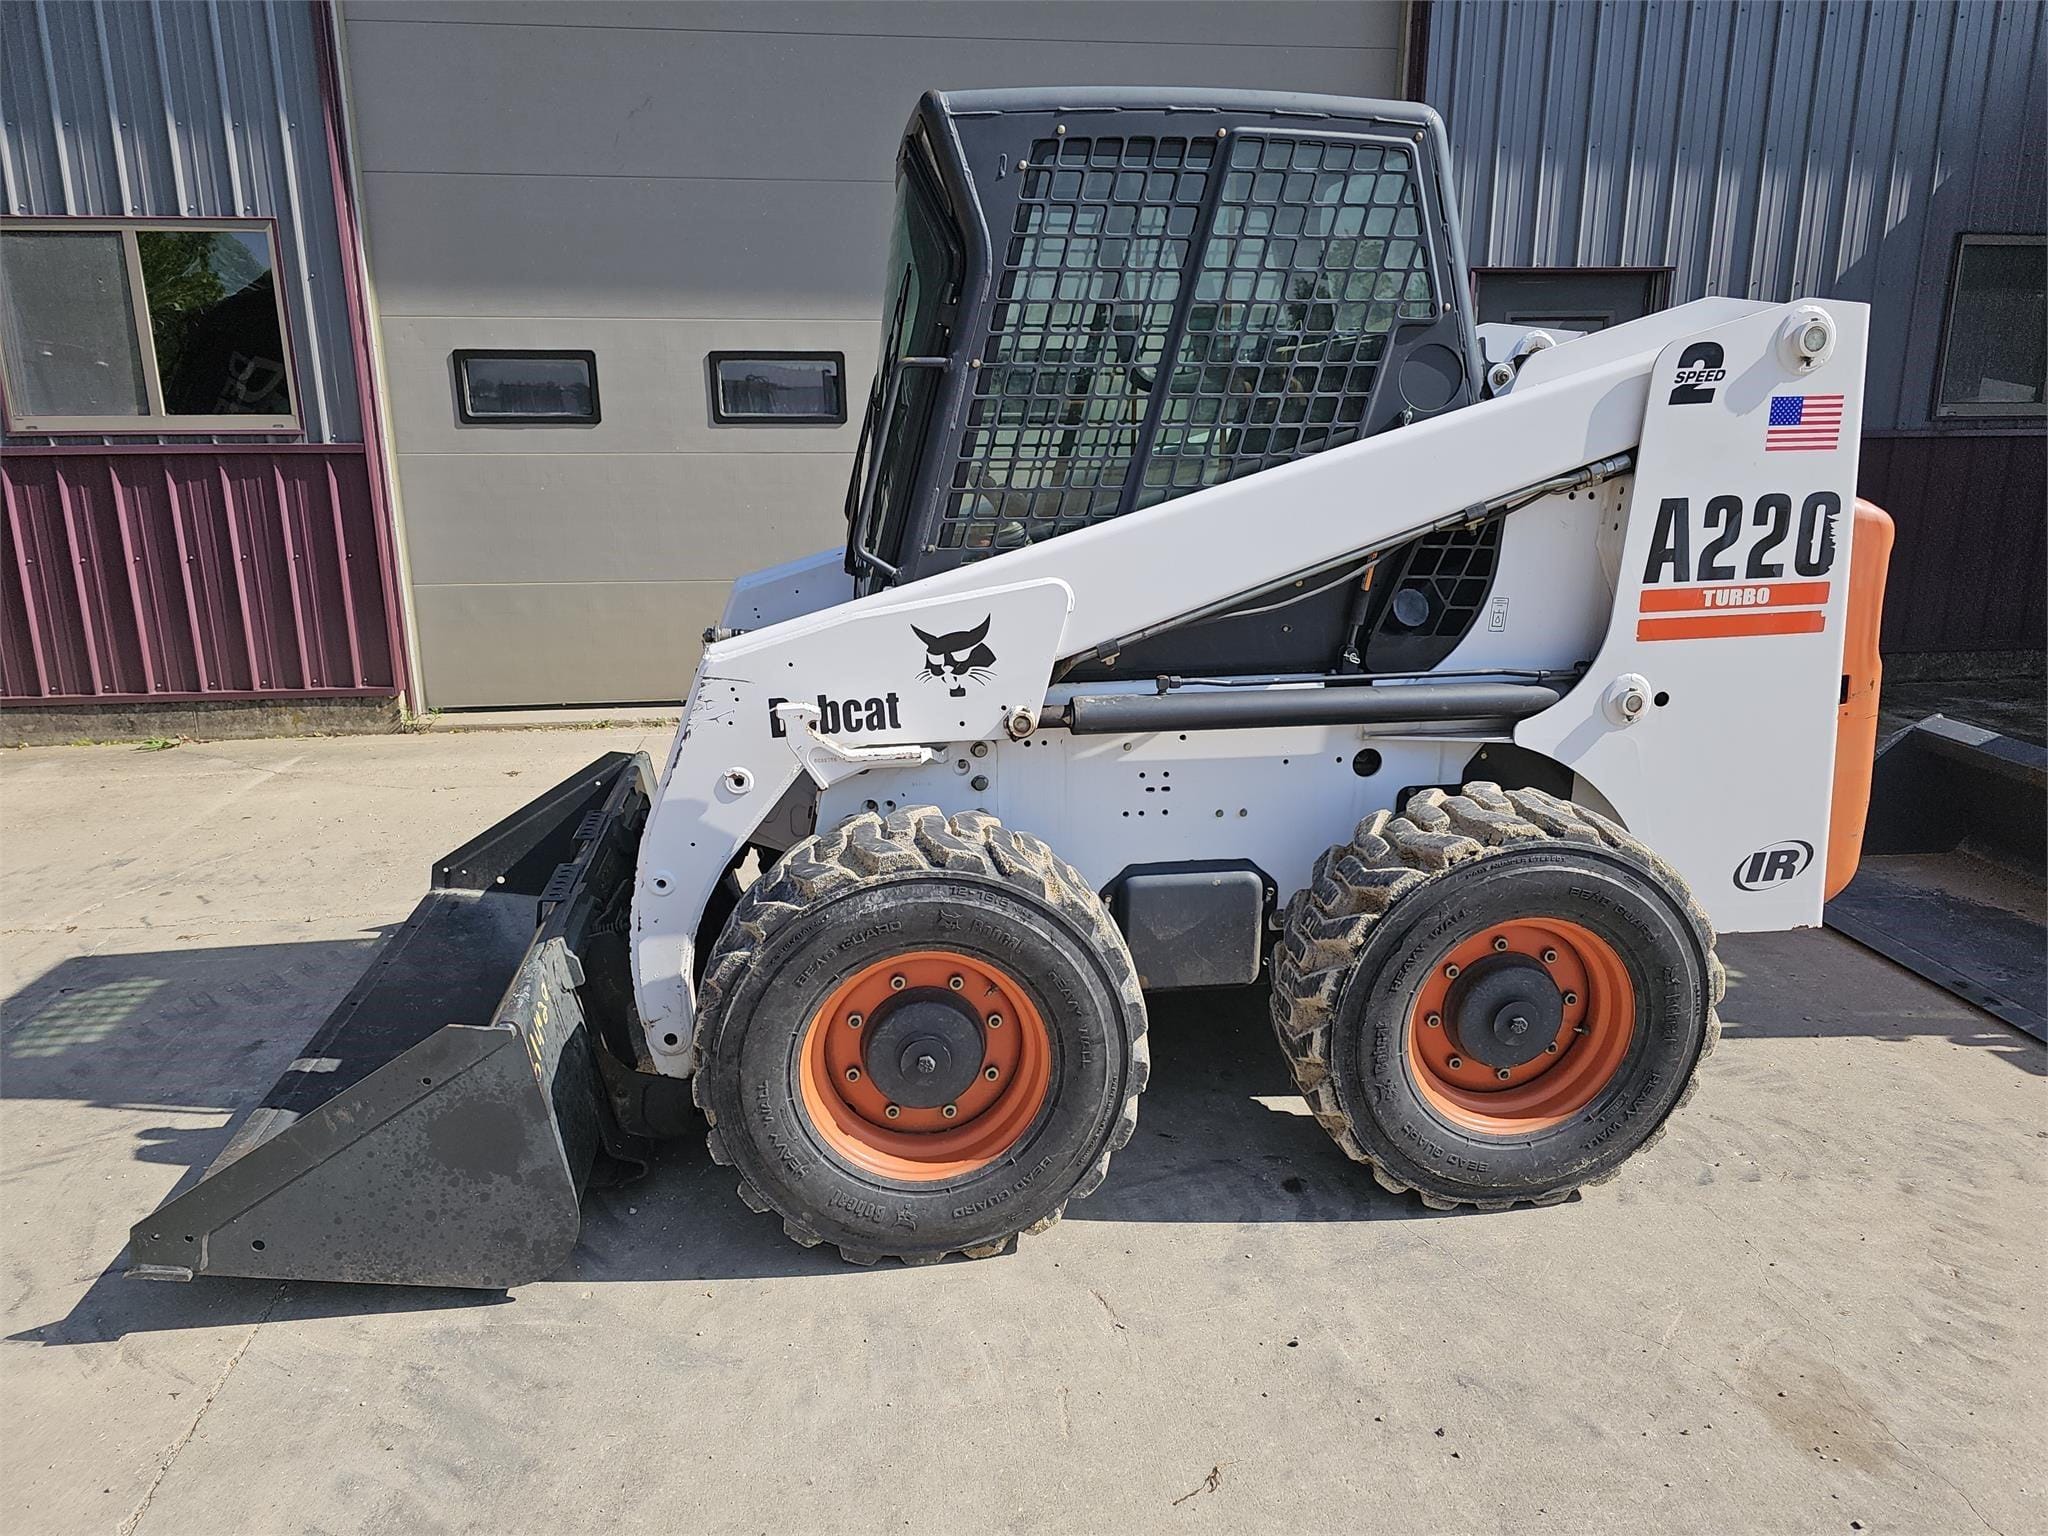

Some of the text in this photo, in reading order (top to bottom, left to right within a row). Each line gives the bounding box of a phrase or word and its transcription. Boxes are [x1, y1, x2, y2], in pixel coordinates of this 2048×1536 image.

[1668, 341, 1727, 405] 2 SPEED
[1642, 491, 1842, 584] A220
[1703, 587, 1770, 607] TURBO
[768, 692, 901, 738] Bbcat
[1744, 849, 1801, 884] IR
